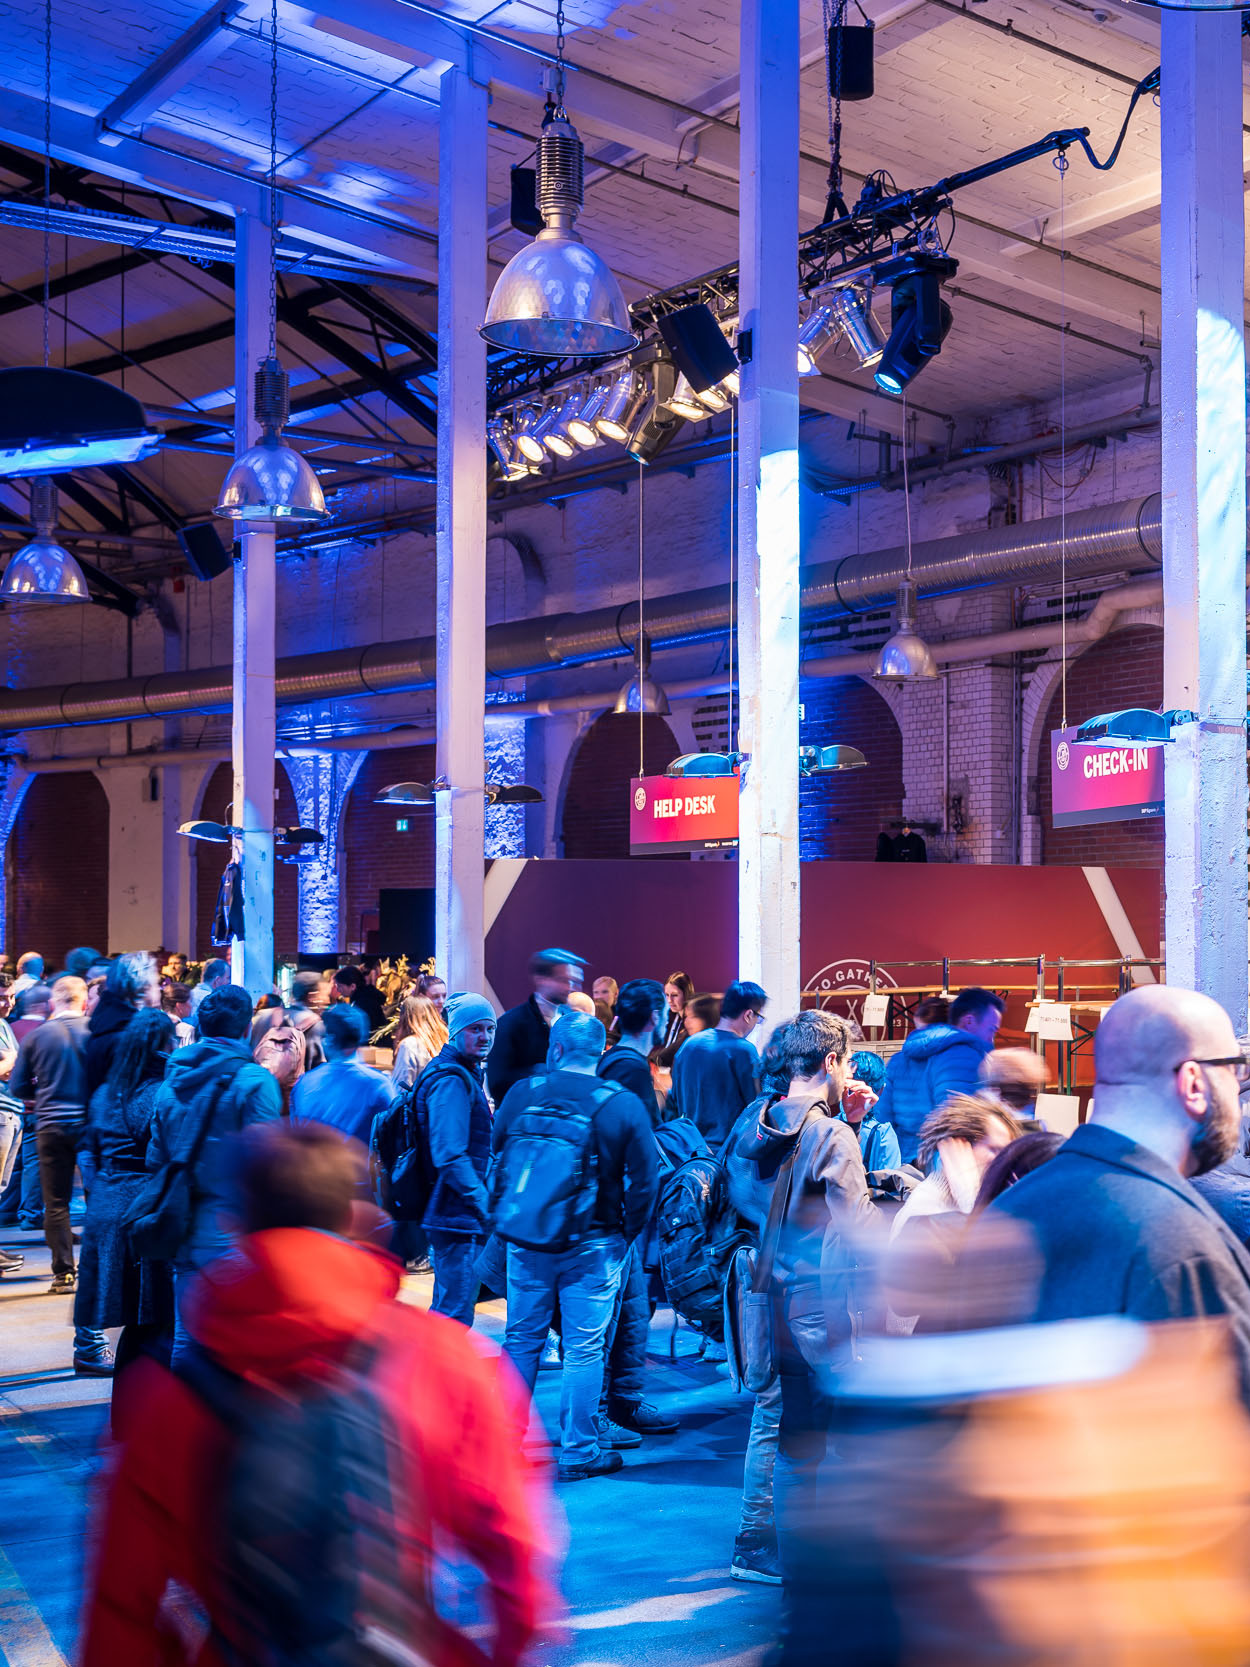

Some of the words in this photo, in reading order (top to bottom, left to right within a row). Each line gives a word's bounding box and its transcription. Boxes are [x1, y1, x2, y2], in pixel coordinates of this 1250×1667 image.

[1083, 748, 1149, 779] CHECK-IN
[653, 798, 683, 819] HELP
[684, 795, 716, 816] DESK
